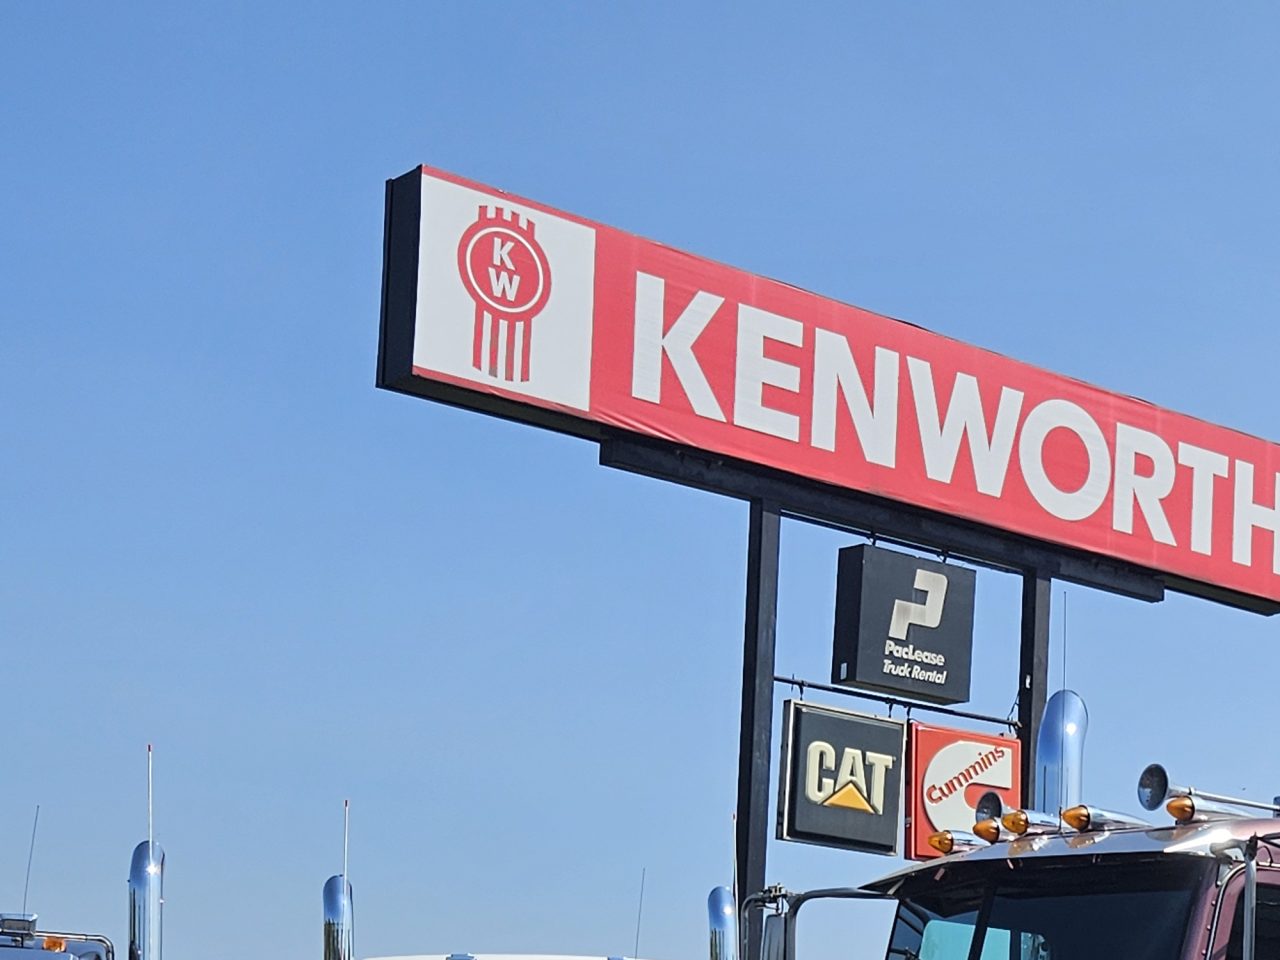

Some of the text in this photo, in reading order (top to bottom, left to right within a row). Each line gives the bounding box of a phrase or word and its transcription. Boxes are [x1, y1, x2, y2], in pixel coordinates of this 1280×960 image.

[883, 659, 947, 685] Truck Rental
[885, 640, 945, 666] PacLease
[805, 741, 893, 816] CAT
[926, 747, 1005, 804] Cummins
